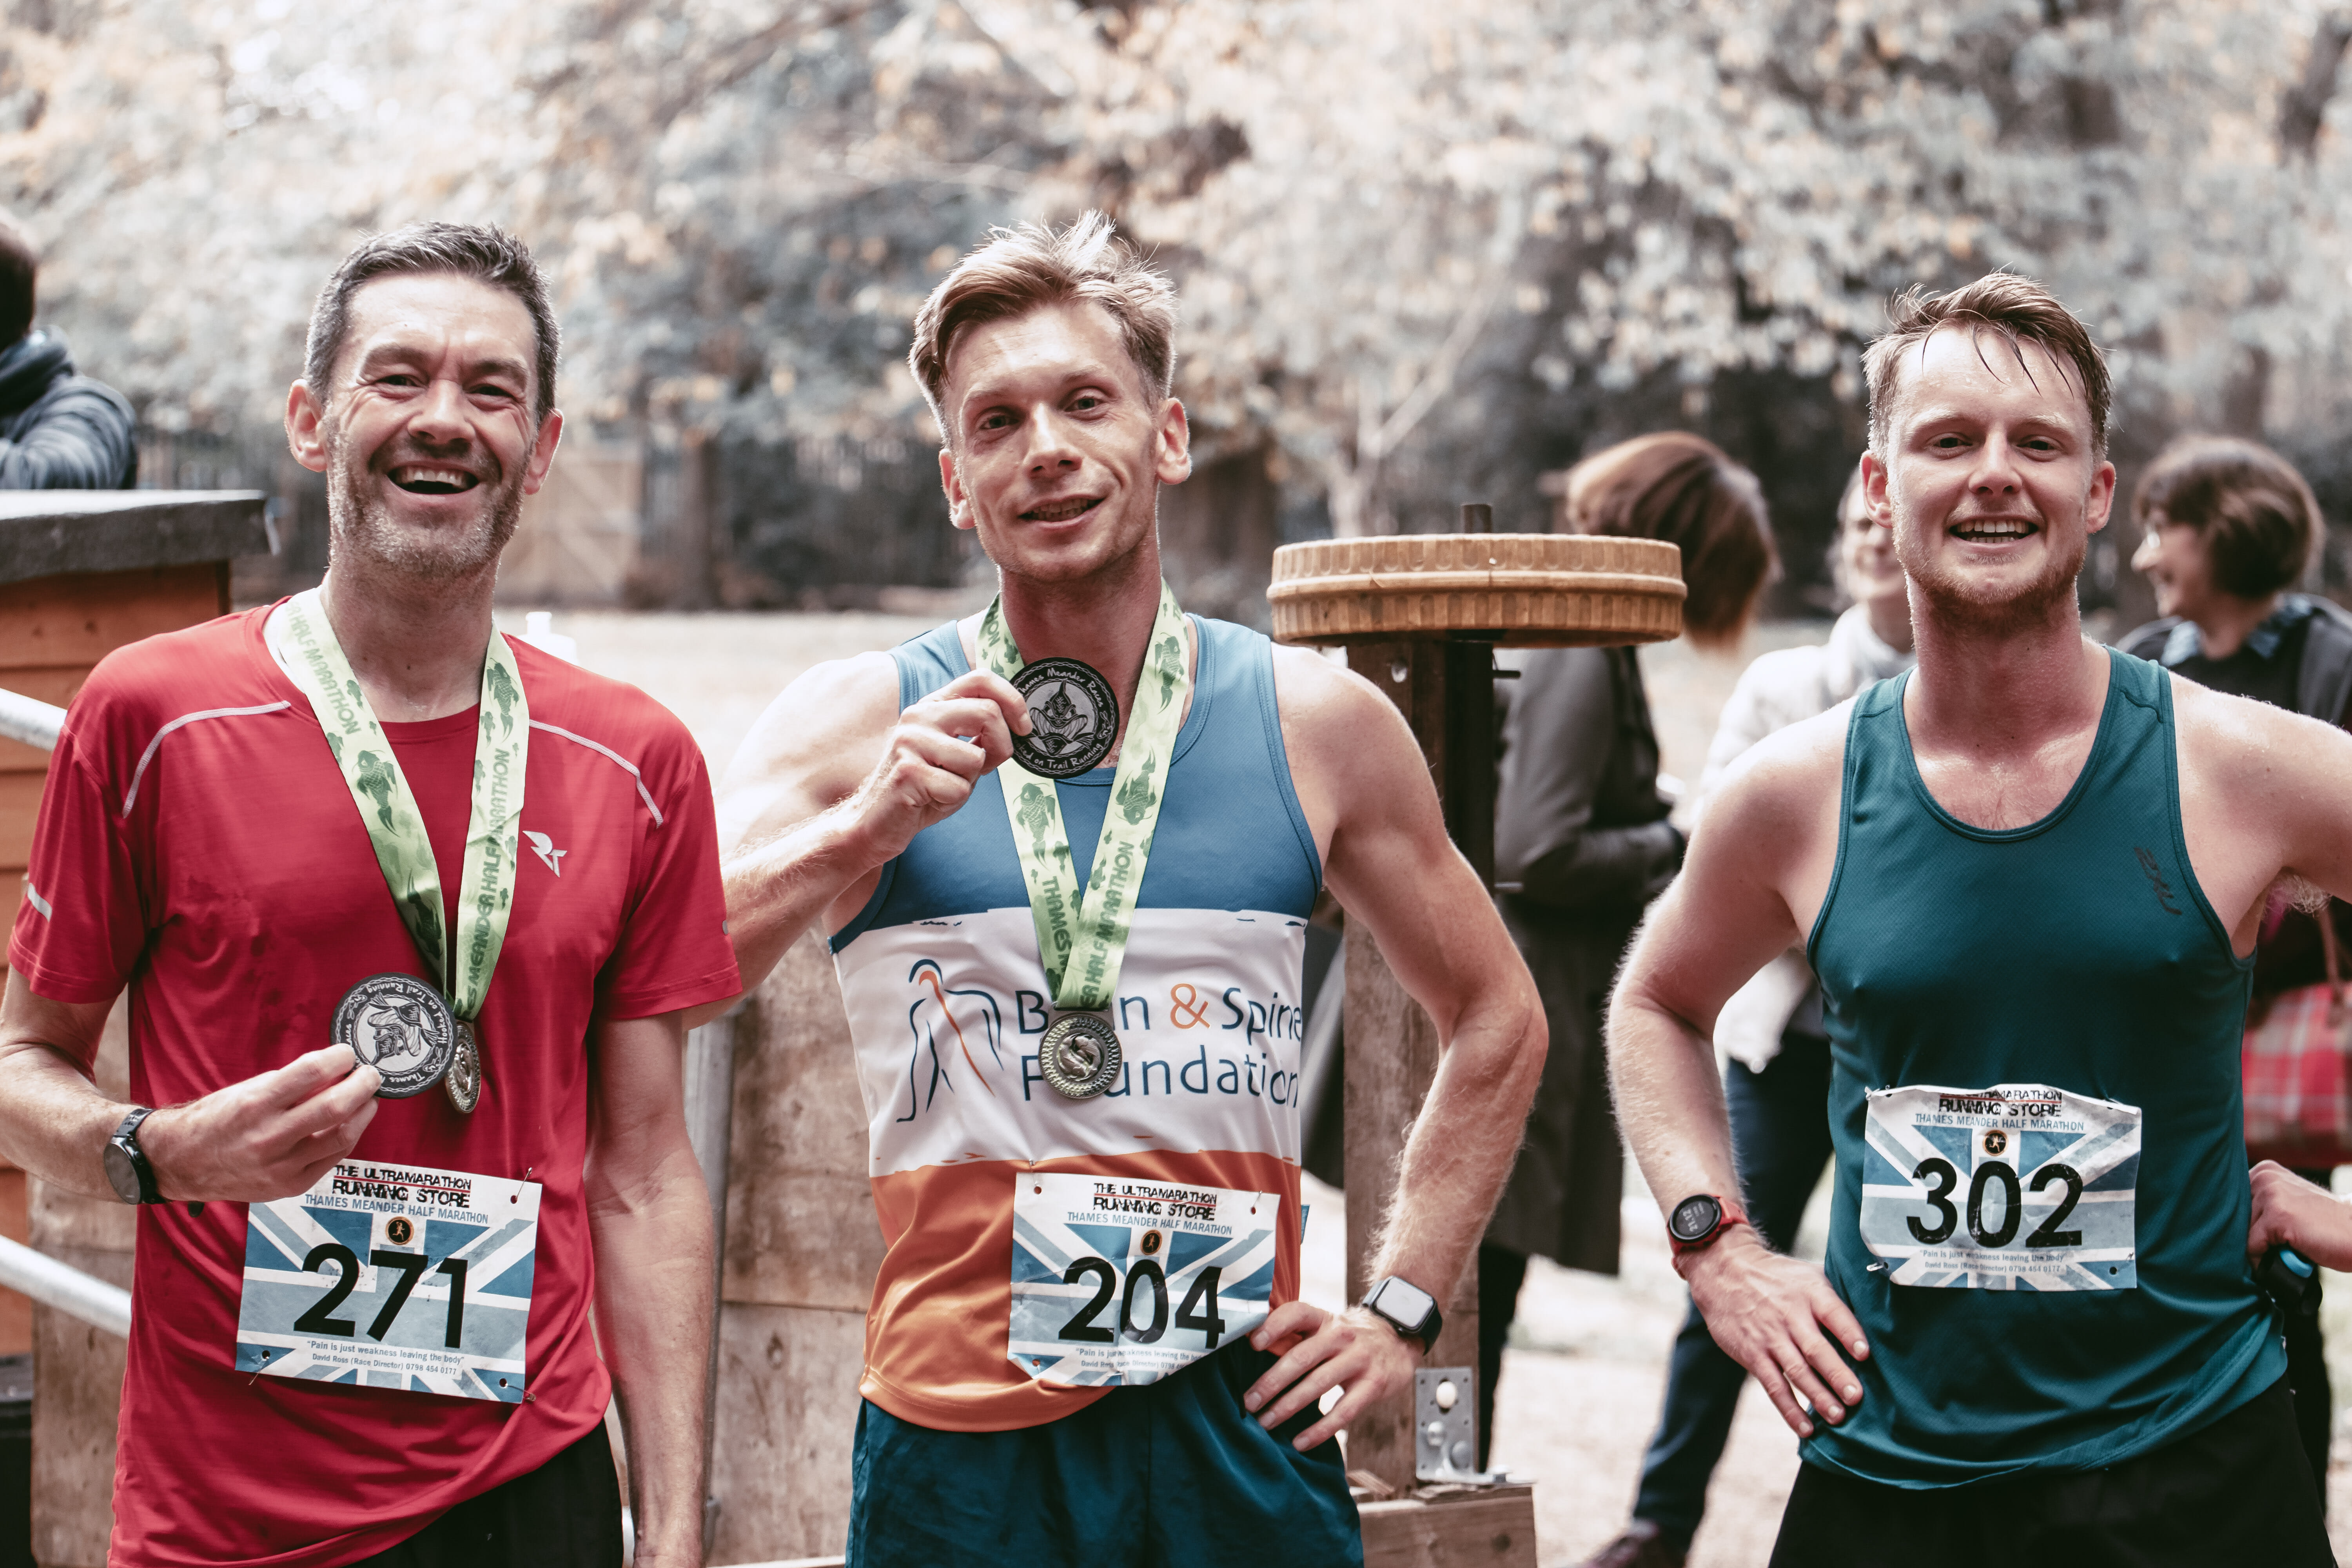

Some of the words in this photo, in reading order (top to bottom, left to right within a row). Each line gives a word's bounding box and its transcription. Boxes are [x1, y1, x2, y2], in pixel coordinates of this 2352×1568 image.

[303, 647, 361, 735] MARATHON
[1017, 675, 1044, 693] hames
[1047, 667, 1086, 682] Meander
[1087, 681, 1103, 707] Races
[1047, 759, 1068, 769] Trail
[1070, 743, 1104, 766] Running
[481, 846, 501, 893] HALF
[1096, 840, 1135, 943] MARATHON
[1042, 876, 1073, 952] THAMES
[468, 893, 495, 986] MEANDER
[1085, 940, 1108, 985] HALF
[366, 982, 404, 993] Running
[406, 984, 427, 1003] Trail
[428, 1000, 437, 1009] on
[1170, 983, 1210, 1029] &
[1222, 987, 1302, 1045] Spine
[434, 1011, 448, 1044] Hooked
[389, 1073, 426, 1083] Thames
[1021, 1044, 1298, 1108] Fundation
[1939, 1098, 2001, 1115] RUNNING
[2008, 1103, 2061, 1117] STORE
[1915, 1113, 1953, 1124] THAMES
[1957, 1116, 1998, 1127] MEANDER
[2002, 1119, 2027, 1128] HALF
[2031, 1119, 2083, 1131] MARATHON
[335, 1165, 359, 1177] THE
[364, 1168, 471, 1190] ULTRAMARATHON
[332, 1179, 408, 1201] RUNNING
[416, 1188, 470, 1208] STORE
[1094, 1183, 1116, 1194] THE
[1122, 1185, 1217, 1204] ULTRAMARATHON
[1906, 1157, 2083, 1248] 302
[305, 1194, 348, 1208] THAMES
[352, 1199, 405, 1214] MEANDER
[408, 1205, 435, 1217] HALF
[438, 1208, 488, 1224] MARATHON
[1093, 1197, 1161, 1215] RUNNING
[1168, 1203, 1216, 1221] STORE
[1067, 1212, 1108, 1223] THAMES
[1112, 1214, 1158, 1227] MEANDER
[1160, 1219, 1181, 1229] HALF
[1183, 1221, 1232, 1235] MARATHON
[1949, 1251, 1963, 1259] just
[1965, 1252, 1999, 1261] weakness
[2002, 1254, 2029, 1263] leaving
[293, 1243, 468, 1349] 271
[1058, 1256, 1225, 1349] 204
[312, 1353, 330, 1361] David
[351, 1357, 371, 1366] (Race
[374, 1359, 403, 1370] Director)
[406, 1363, 423, 1371] 0798
[440, 1367, 457, 1375] 0177
[339, 1343, 355, 1353] just
[358, 1347, 397, 1357] weakness
[400, 1350, 427, 1361] leaving
[1154, 1350, 1178, 1361] leaving
